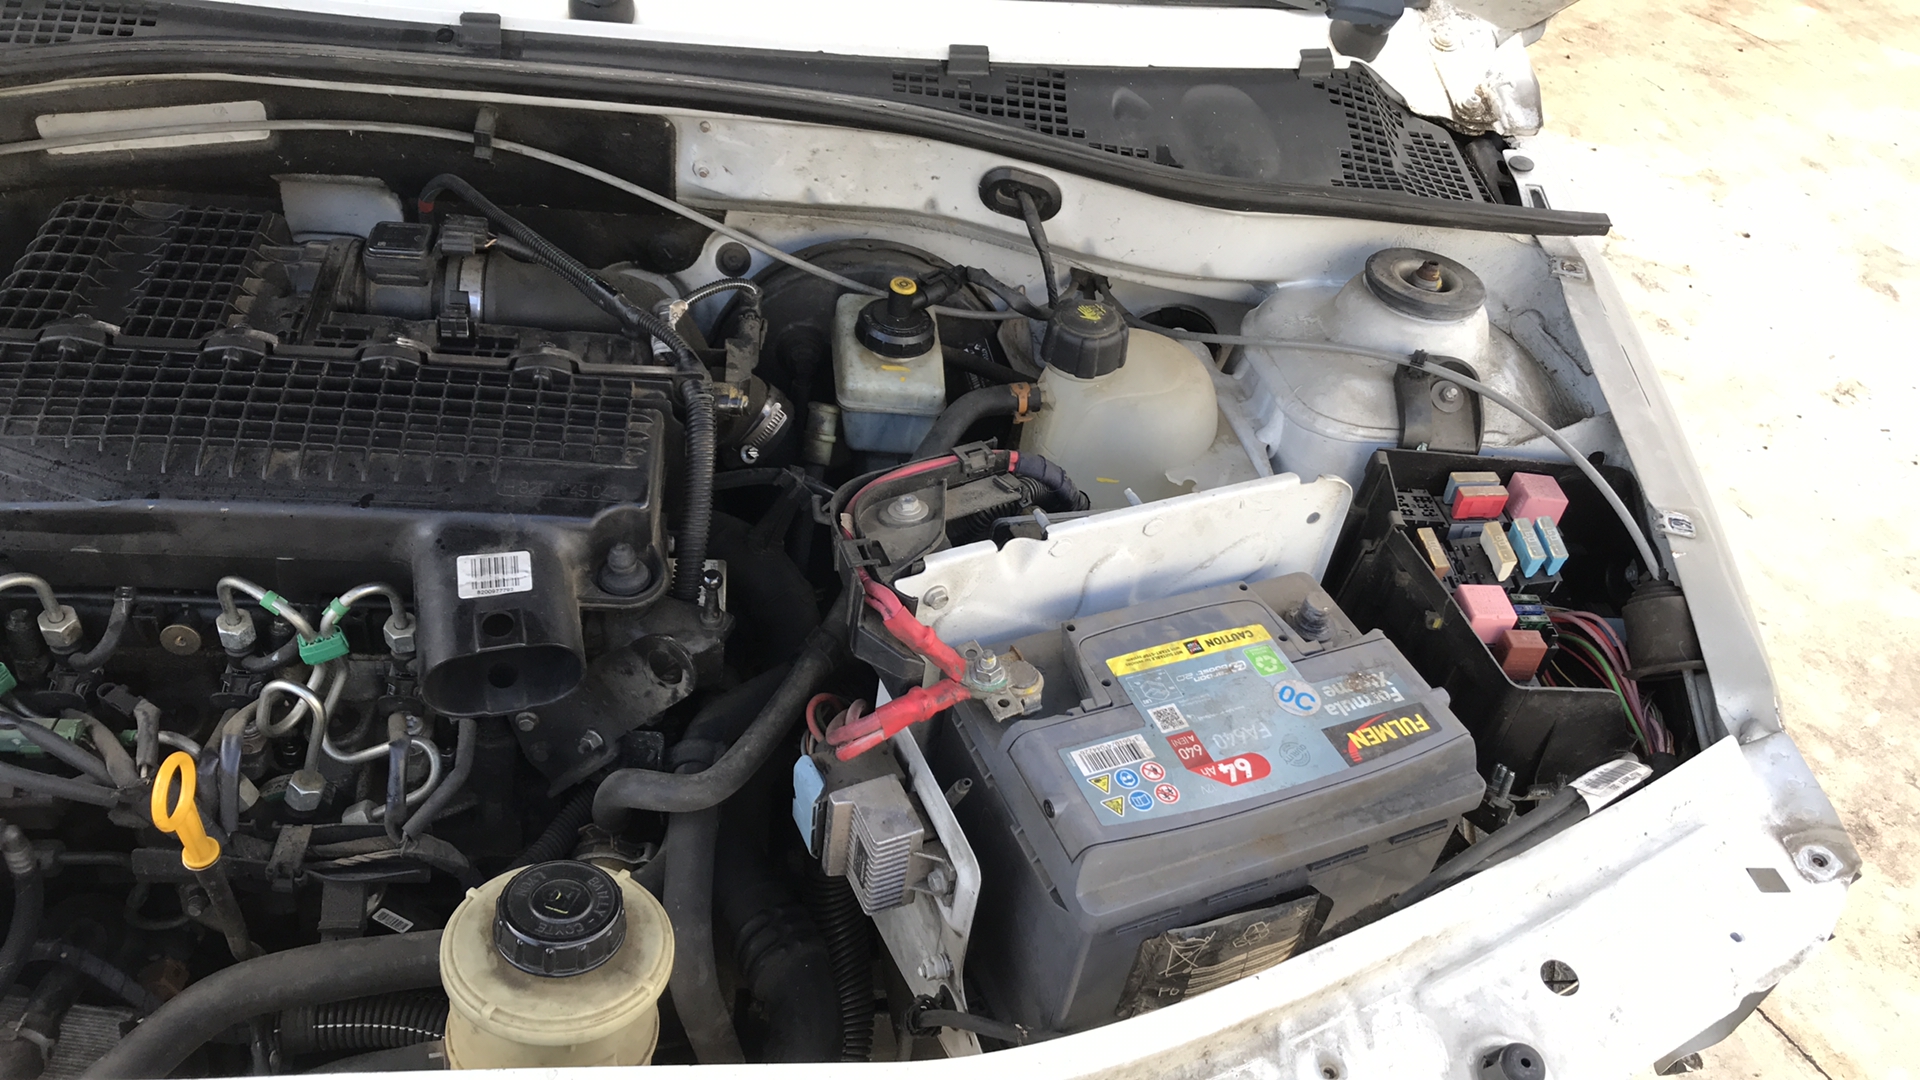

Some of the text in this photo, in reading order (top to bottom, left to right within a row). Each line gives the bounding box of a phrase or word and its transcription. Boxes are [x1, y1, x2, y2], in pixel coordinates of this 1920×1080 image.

[1205, 630, 1253, 647] CAUTION
[1323, 687, 1404, 716] Formula
[1212, 721, 1273, 750] FA640
[1346, 713, 1430, 748] FULMEN
[1177, 744, 1203, 760] 640
[1200, 757, 1253, 783] 64 Ah
[1202, 783, 1217, 795] 12V
